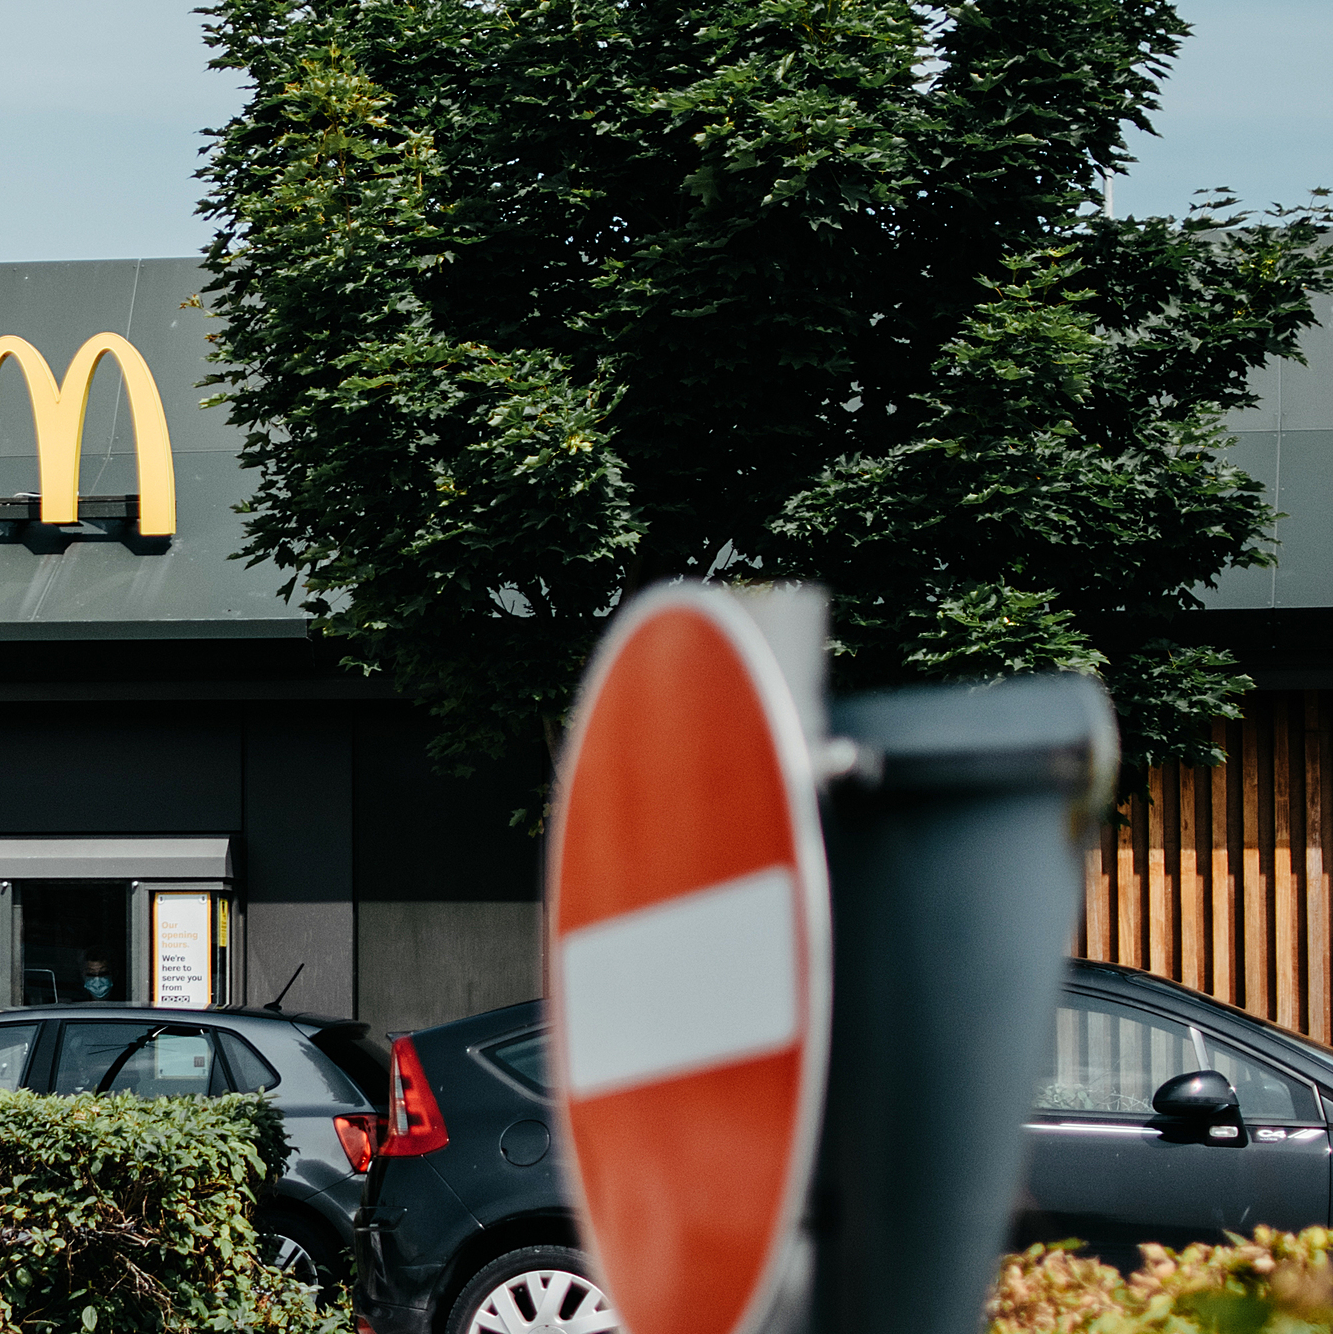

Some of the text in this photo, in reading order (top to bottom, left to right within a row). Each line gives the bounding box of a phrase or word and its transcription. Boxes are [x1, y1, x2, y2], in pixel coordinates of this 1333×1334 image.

[161, 921, 178, 929] Our
[161, 931, 198, 940] opening
[162, 954, 186, 962] We're
[162, 964, 181, 972] here
[187, 975, 203, 983] you
